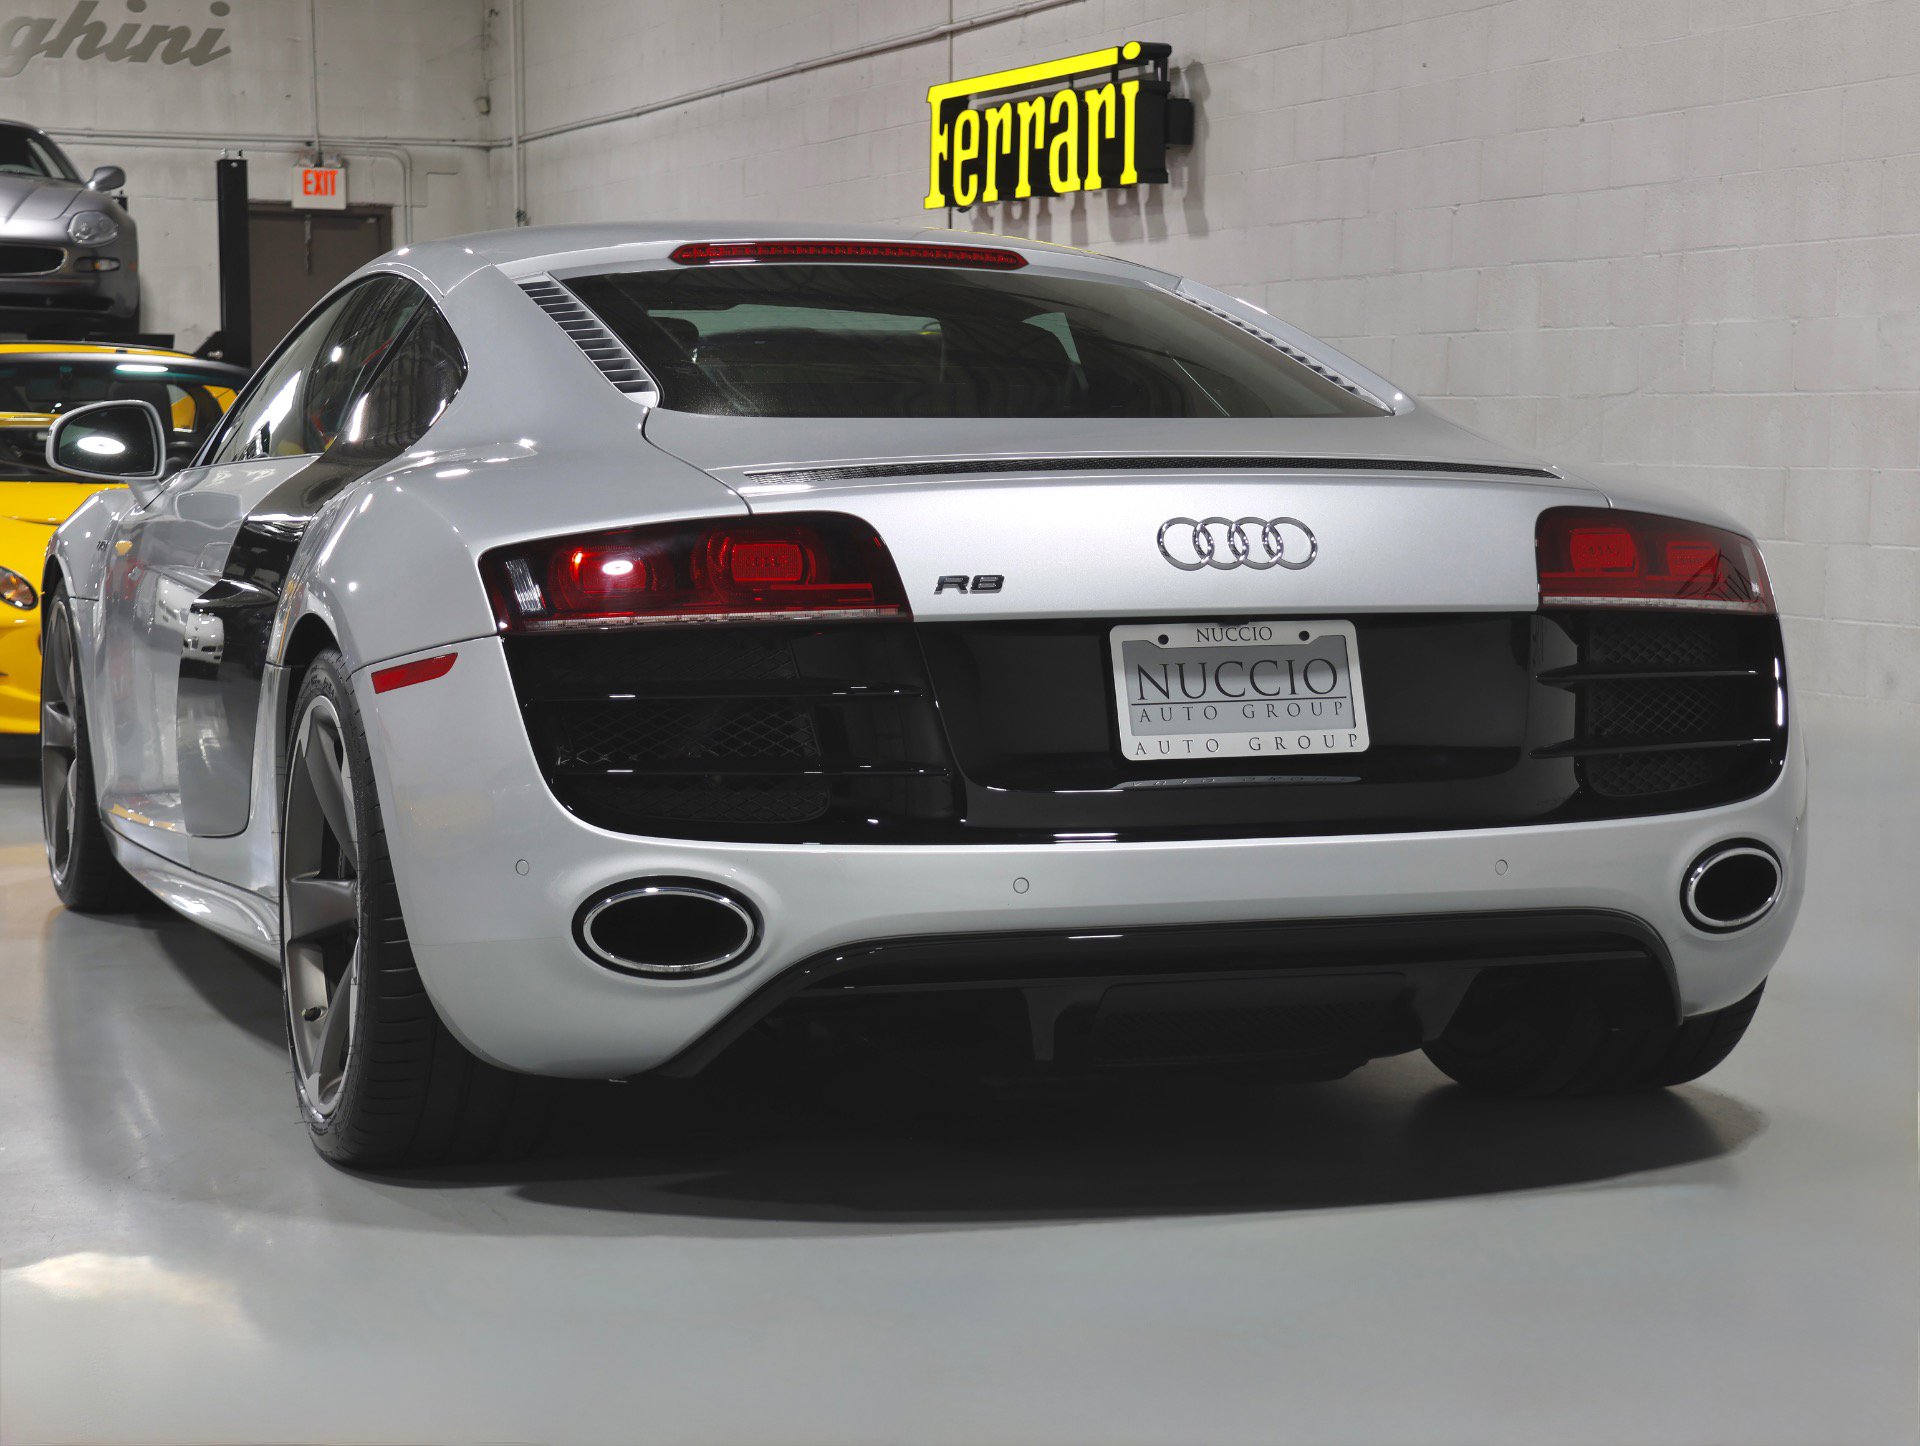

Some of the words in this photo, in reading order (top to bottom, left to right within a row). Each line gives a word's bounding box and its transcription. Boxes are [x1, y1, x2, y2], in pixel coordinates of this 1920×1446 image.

[0, 0, 232, 78] ghini
[923, 41, 1141, 210] Ferrari
[302, 169, 338, 196] EXIT
[934, 574, 1005, 595] R8
[1196, 626, 1273, 643] NUCCIO
[1137, 658, 1338, 701] NUCCIO
[1139, 705, 1218, 723] AUTO
[1242, 701, 1343, 719] GROUP
[1134, 738, 1220, 756] AUTO
[1248, 733, 1358, 751] GROUP
